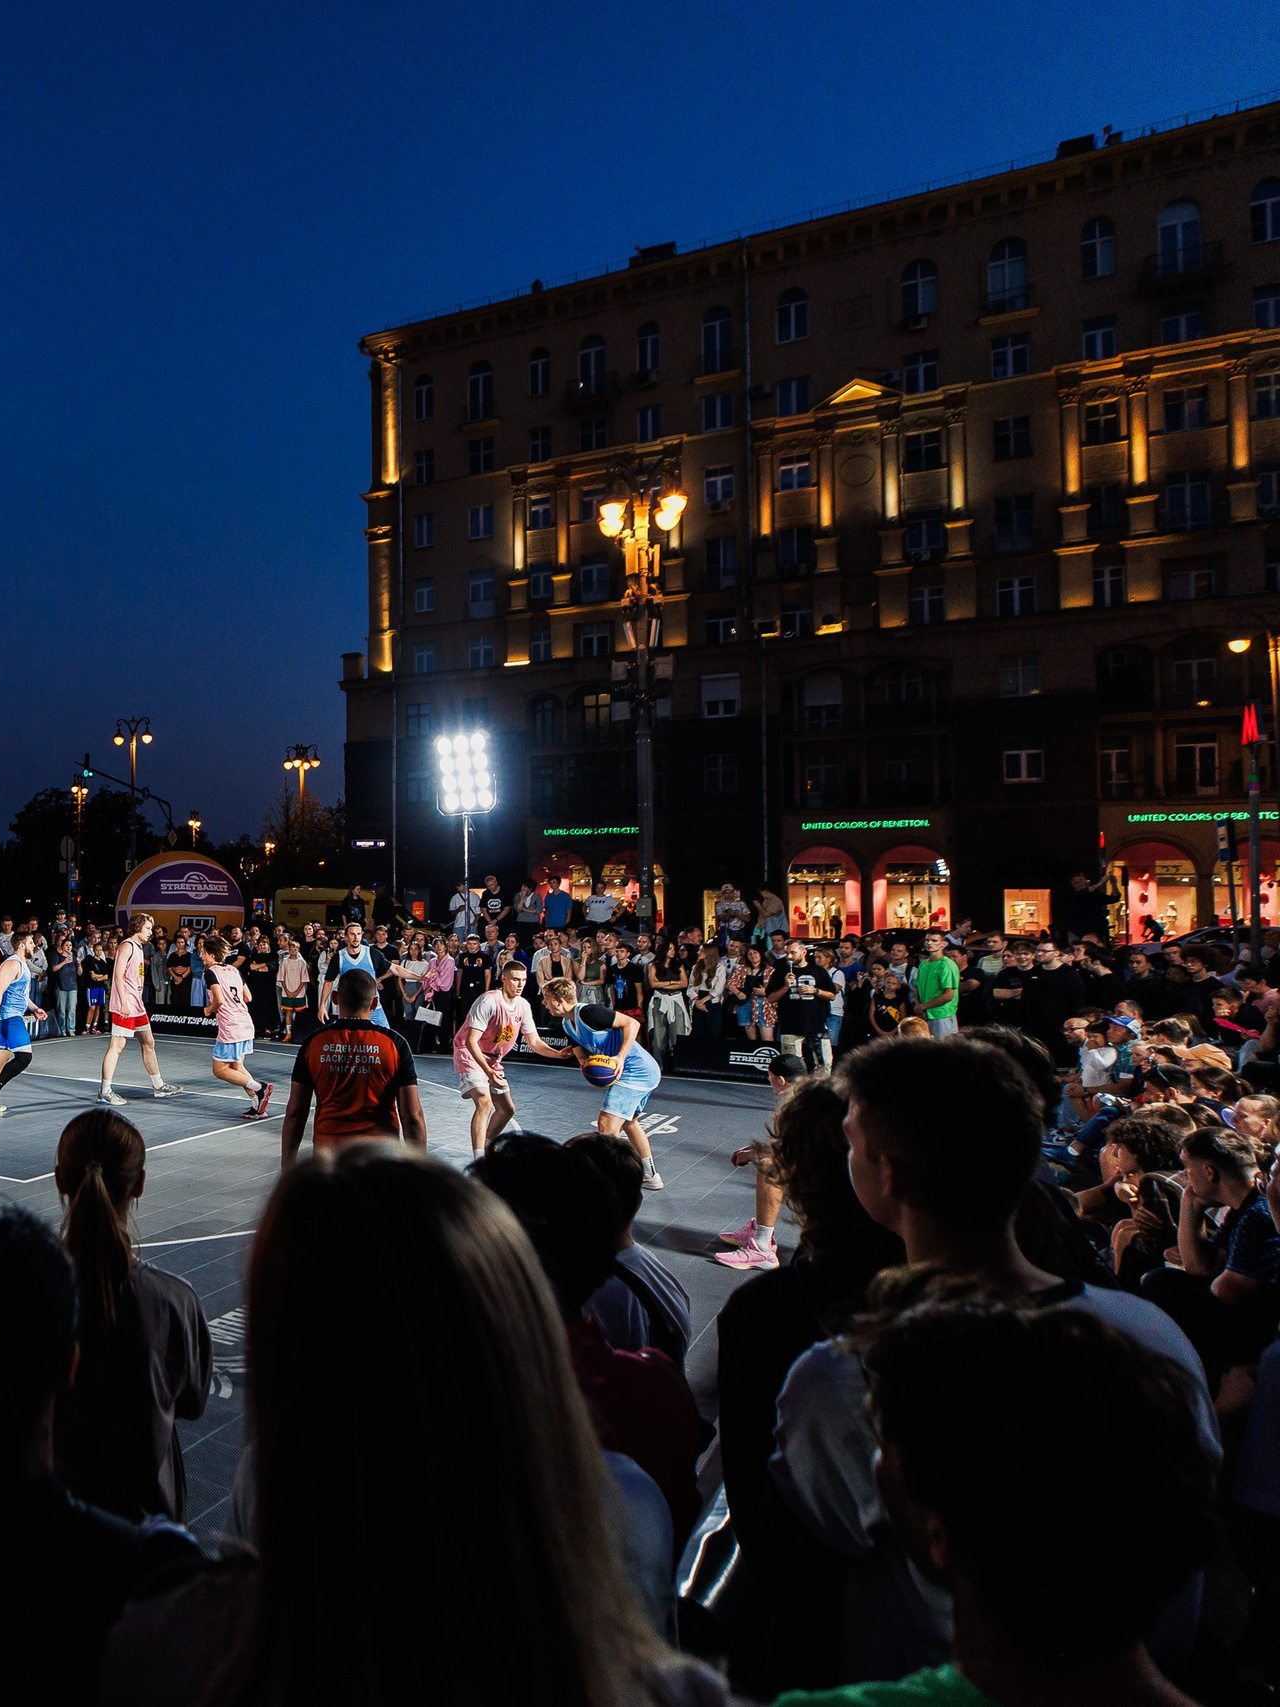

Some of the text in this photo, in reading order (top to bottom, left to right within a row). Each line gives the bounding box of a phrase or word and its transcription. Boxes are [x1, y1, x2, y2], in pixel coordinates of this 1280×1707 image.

[1127, 813, 1167, 823] UNITED
[1168, 812, 1212, 822] COLORS
[1213, 812, 1230, 821] OF
[801, 822, 833, 831] UNITED
[834, 821, 869, 830] COLORS
[869, 820, 882, 829] OF
[543, 828, 569, 836] UNITED
[160, 883, 228, 892] STREETBASKET
[230, 986, 241, 1003] 3
[322, 1044, 380, 1054] ФЕДЕРАЦИЯ
[320, 1054, 381, 1064] БАСКЕБОЛА
[729, 1055, 772, 1064] STREETB
